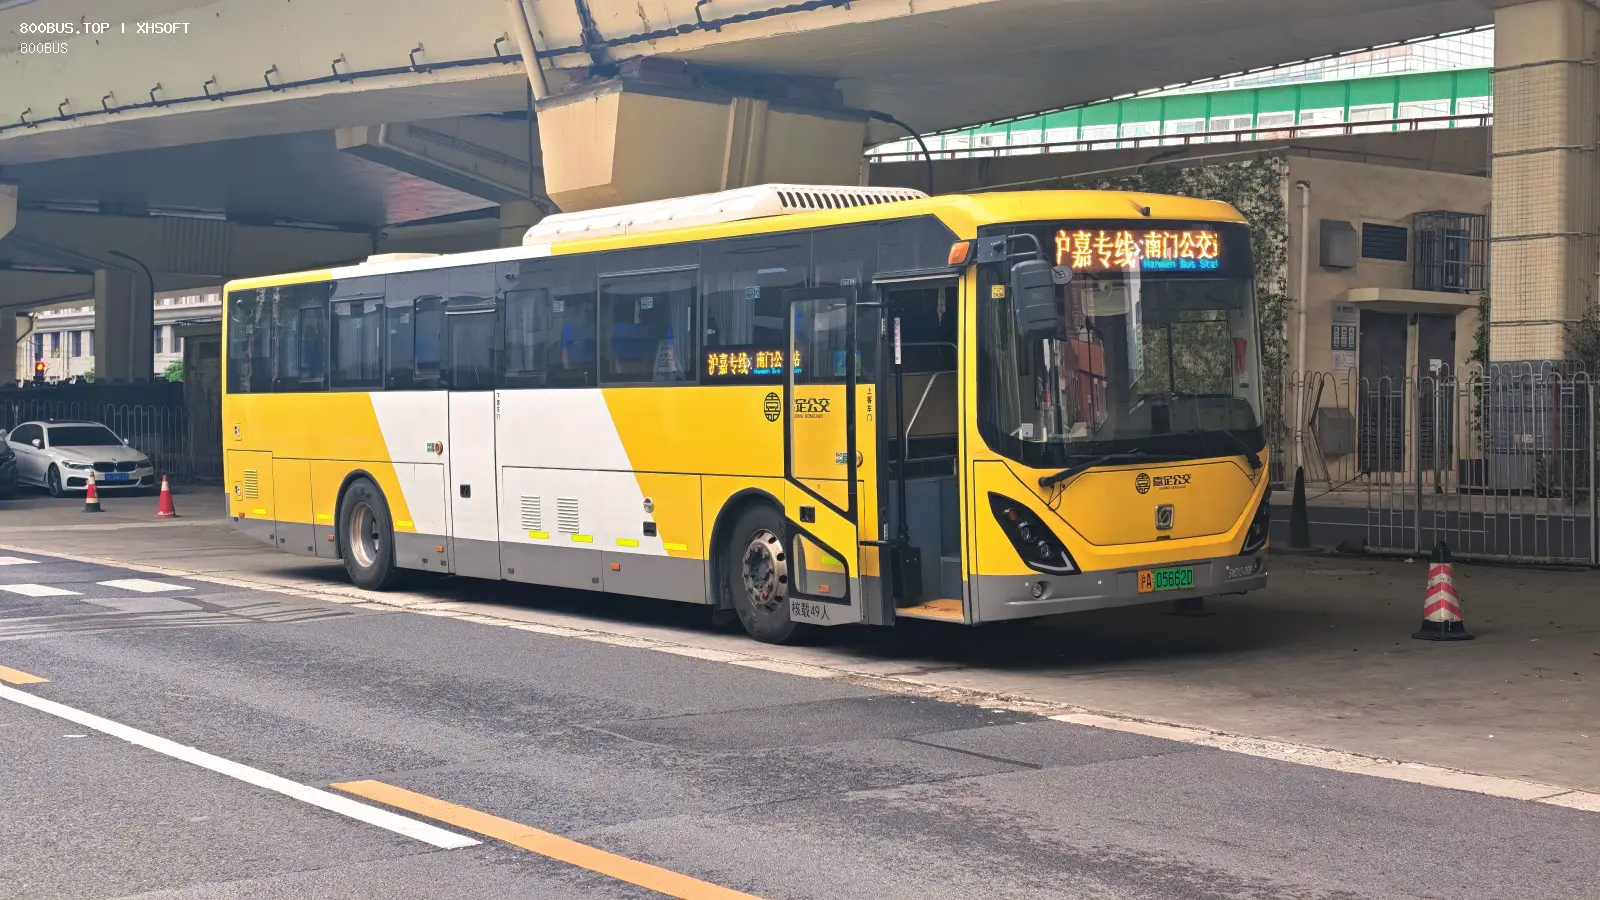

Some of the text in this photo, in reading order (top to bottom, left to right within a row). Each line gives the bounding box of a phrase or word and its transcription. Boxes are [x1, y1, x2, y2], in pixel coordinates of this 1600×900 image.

[708, 352, 749, 375] 沪嘉专线
[794, 398, 831, 413] 定公交
[791, 601, 830, 621] 核载49人
